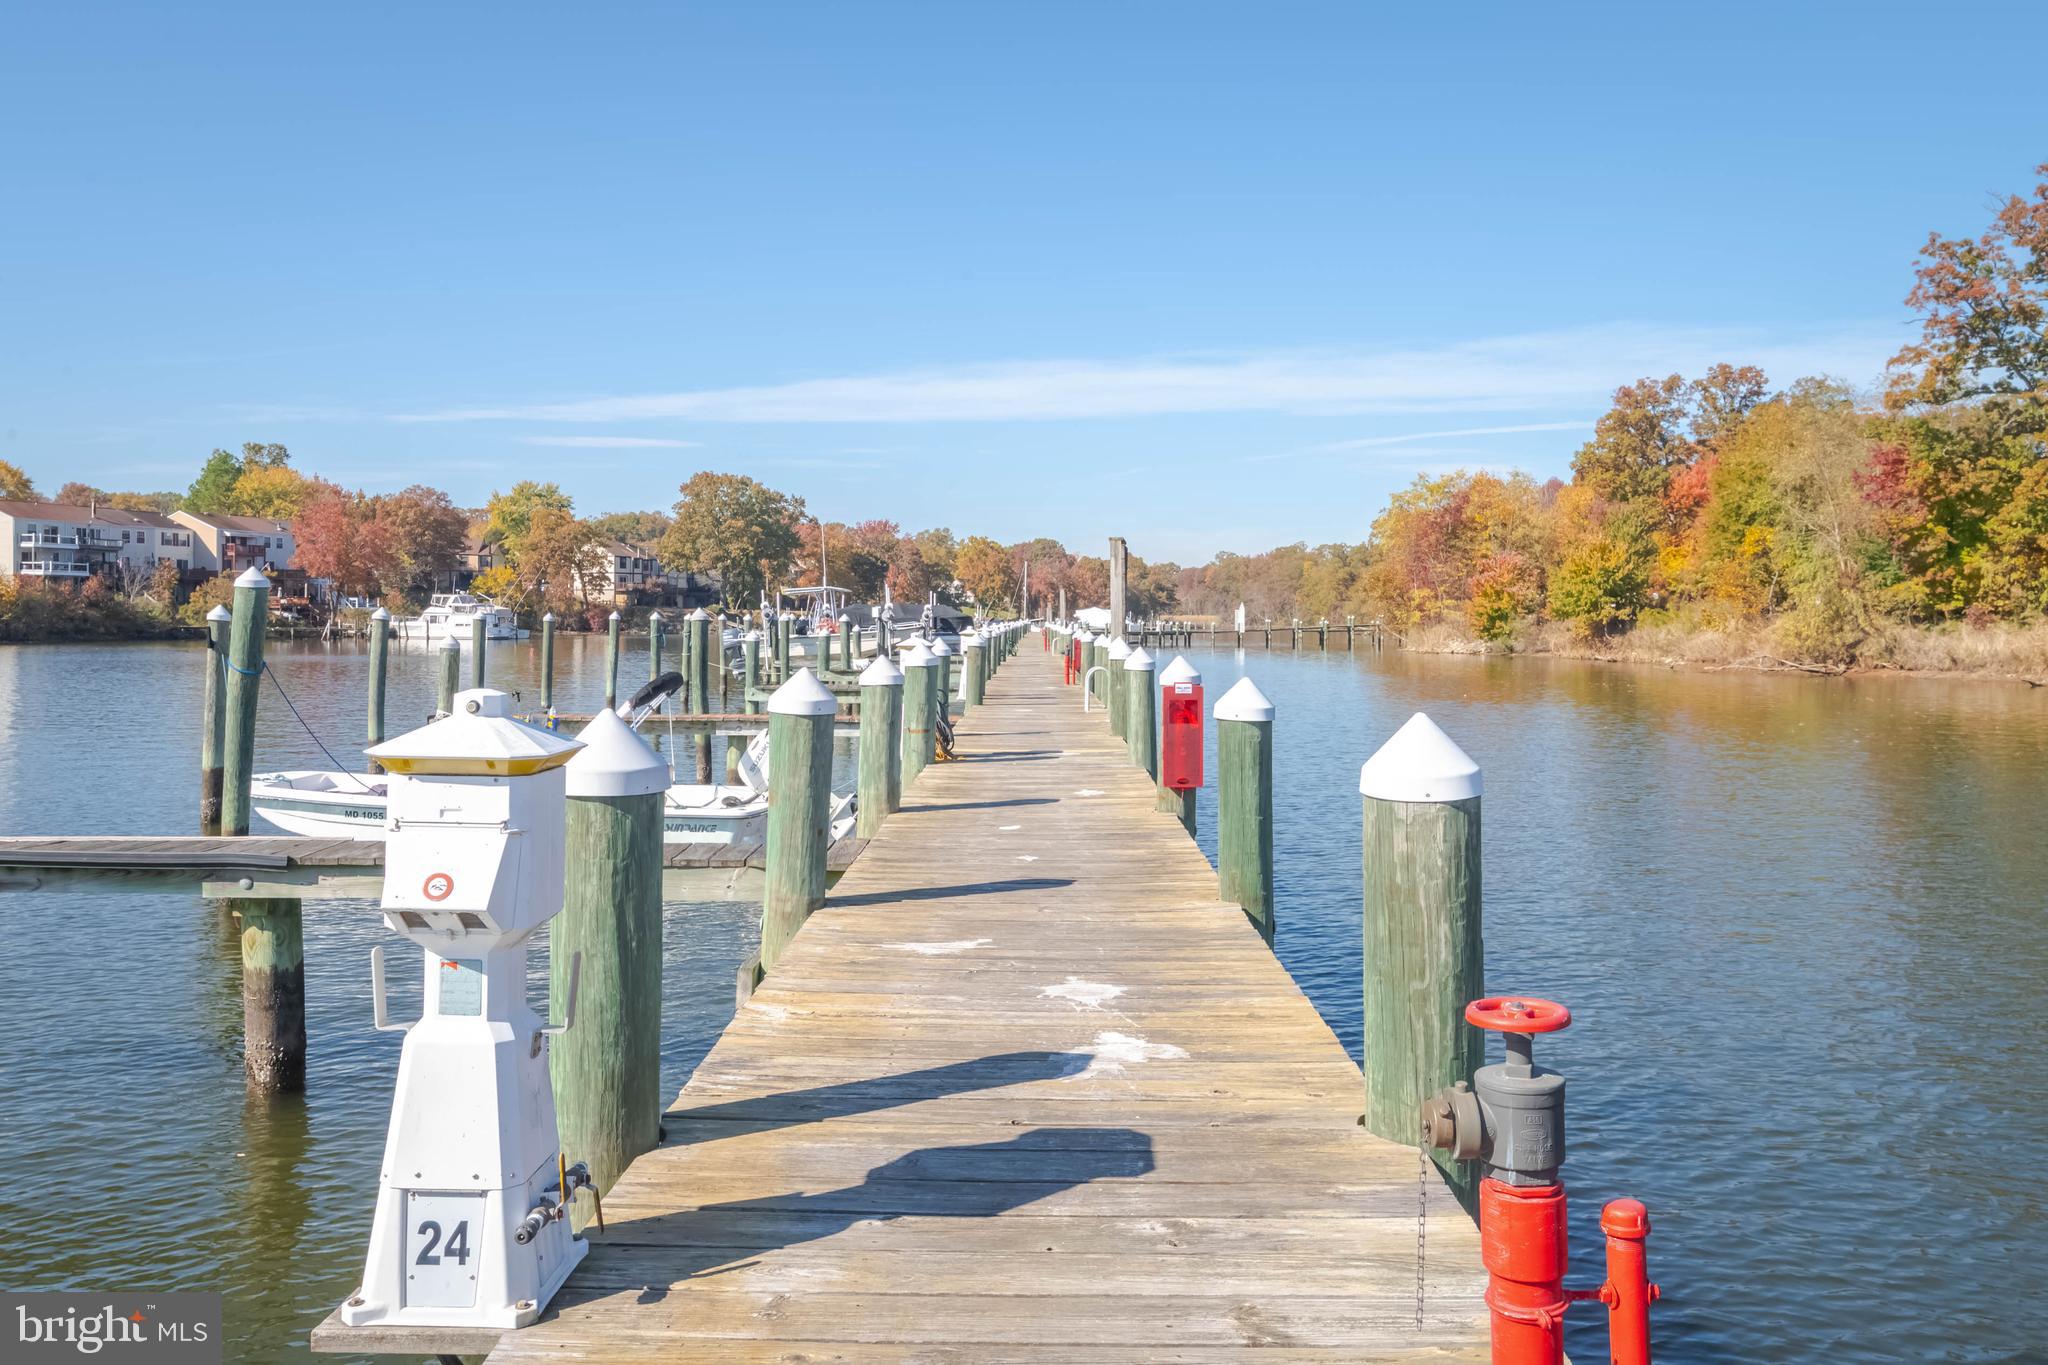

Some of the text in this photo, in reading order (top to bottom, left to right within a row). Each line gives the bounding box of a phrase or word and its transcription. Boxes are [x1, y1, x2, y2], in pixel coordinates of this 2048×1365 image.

[345, 810, 384, 820] MD 1055
[415, 1220, 471, 1266] 24
